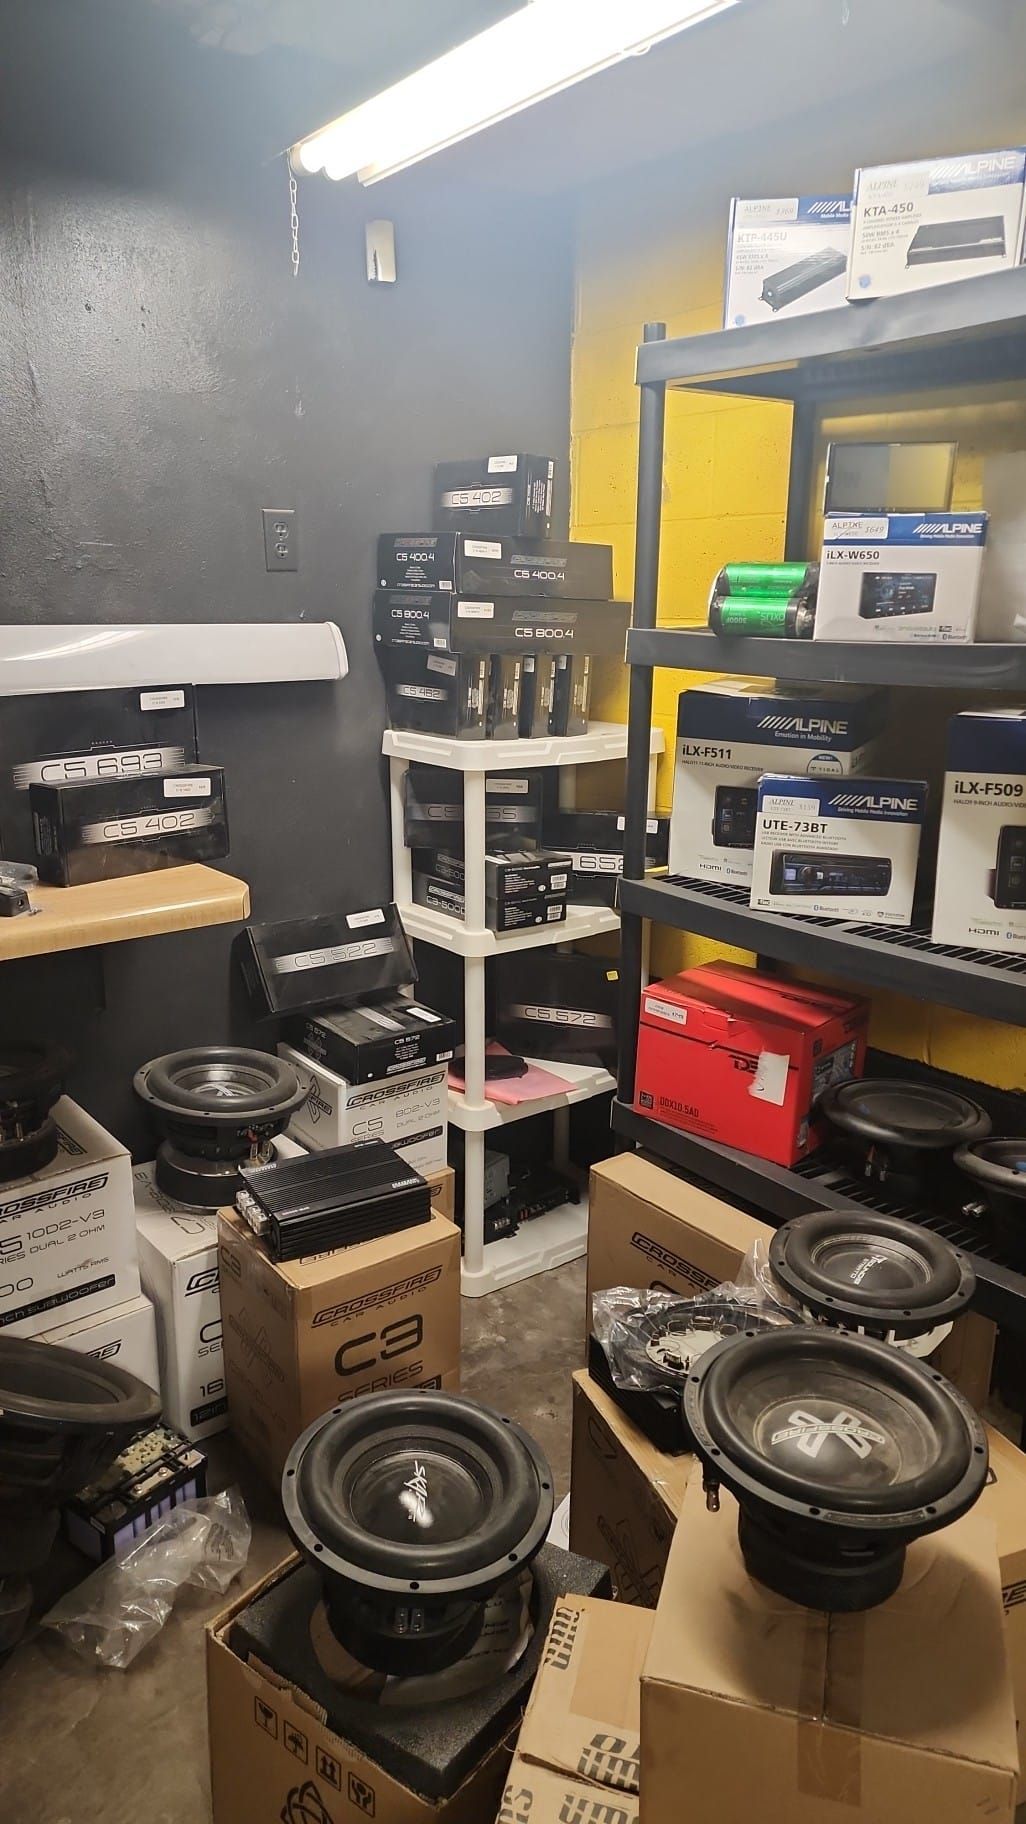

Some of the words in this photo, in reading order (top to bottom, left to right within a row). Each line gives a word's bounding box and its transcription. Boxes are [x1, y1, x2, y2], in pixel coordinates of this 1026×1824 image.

[944, 157, 1017, 177] ALPINE
[863, 202, 914, 218] KTA-450
[472, 491, 502, 503] 402
[926, 523, 983, 534] ALPINE
[826, 550, 880, 560] iLX-W650
[532, 570, 565, 581] 400.4
[535, 628, 574, 639] 800.4
[773, 716, 849, 735] ALPINE
[682, 744, 732, 760] iLX-F511
[97, 753, 163, 776] 693
[954, 780, 1024, 797] iLX-F509
[845, 794, 919, 811] ALPINE
[145, 813, 195, 832] 402
[763, 819, 828, 834] UTE-73BT
[331, 942, 378, 961] 522
[555, 1010, 597, 1025] 572
[347, 1071, 446, 1110] CROSSFIRE
[35, 1192, 92, 1213] AUDIO
[29, 1239, 65, 1255] DUAL
[67, 1233, 77, 1242] 2
[78, 1223, 106, 1239] OHM
[90, 1256, 110, 1268] RMS
[313, 1267, 441, 1326] CROSSFIRE
[334, 1313, 424, 1377] C3
